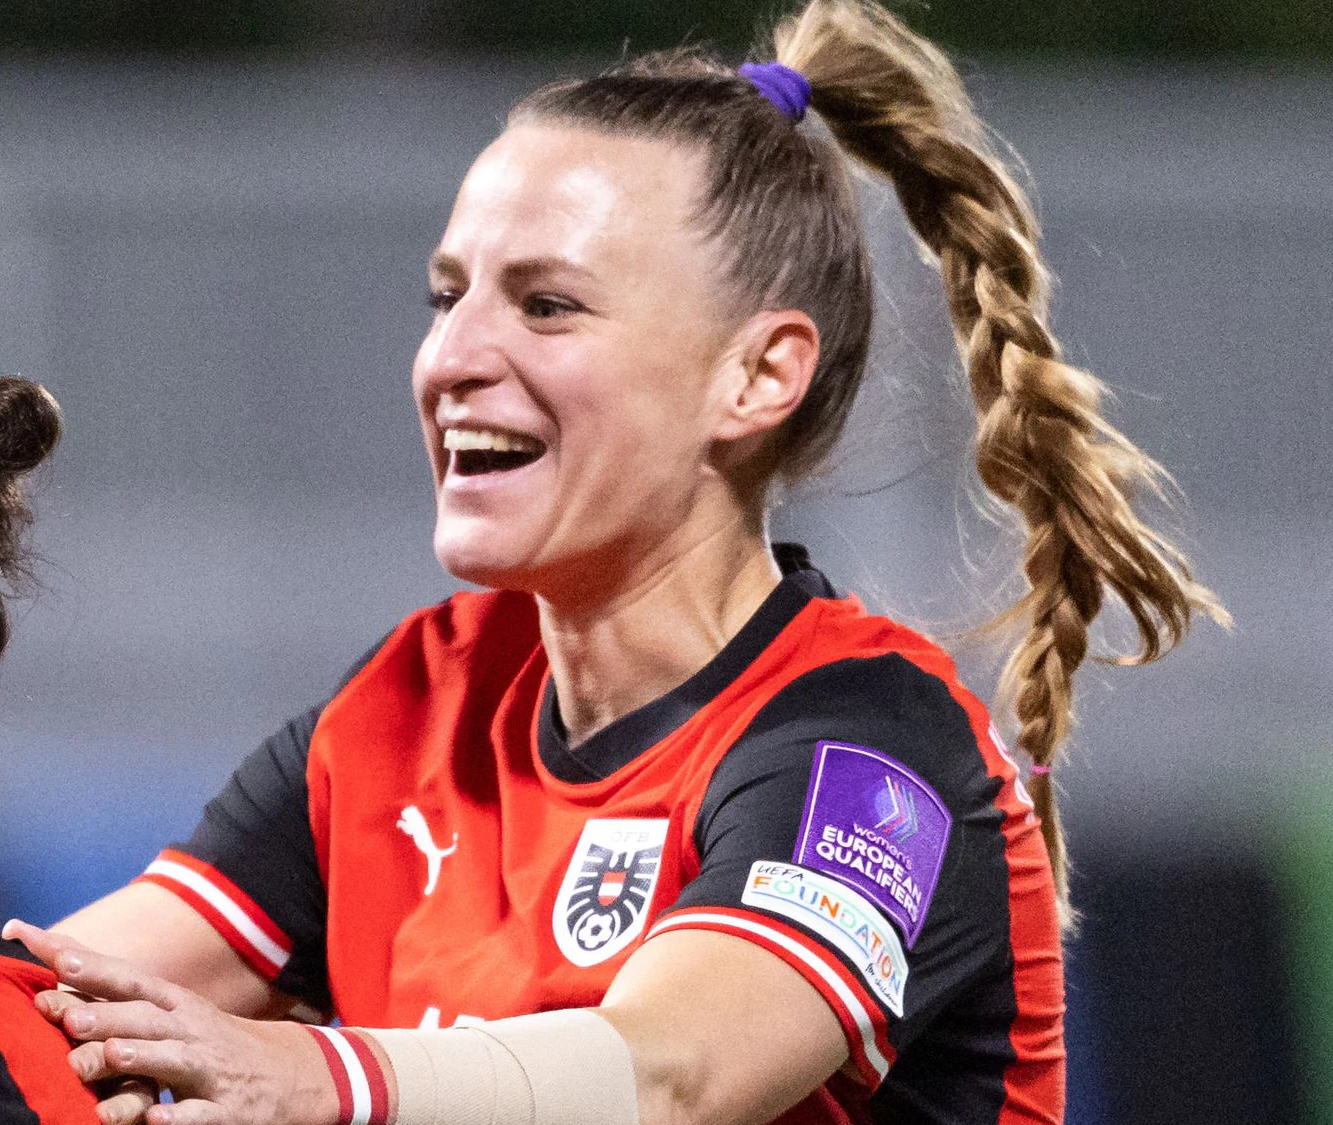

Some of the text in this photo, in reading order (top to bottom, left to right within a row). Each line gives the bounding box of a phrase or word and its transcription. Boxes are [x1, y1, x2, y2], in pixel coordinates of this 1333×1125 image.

[757, 864, 805, 881] UEFA
[816, 841, 919, 923] QUALIFIERS
[822, 824, 922, 904] EUROPEAN
[853, 823, 913, 870] women's
[753, 875, 901, 996] FOUNDATION
